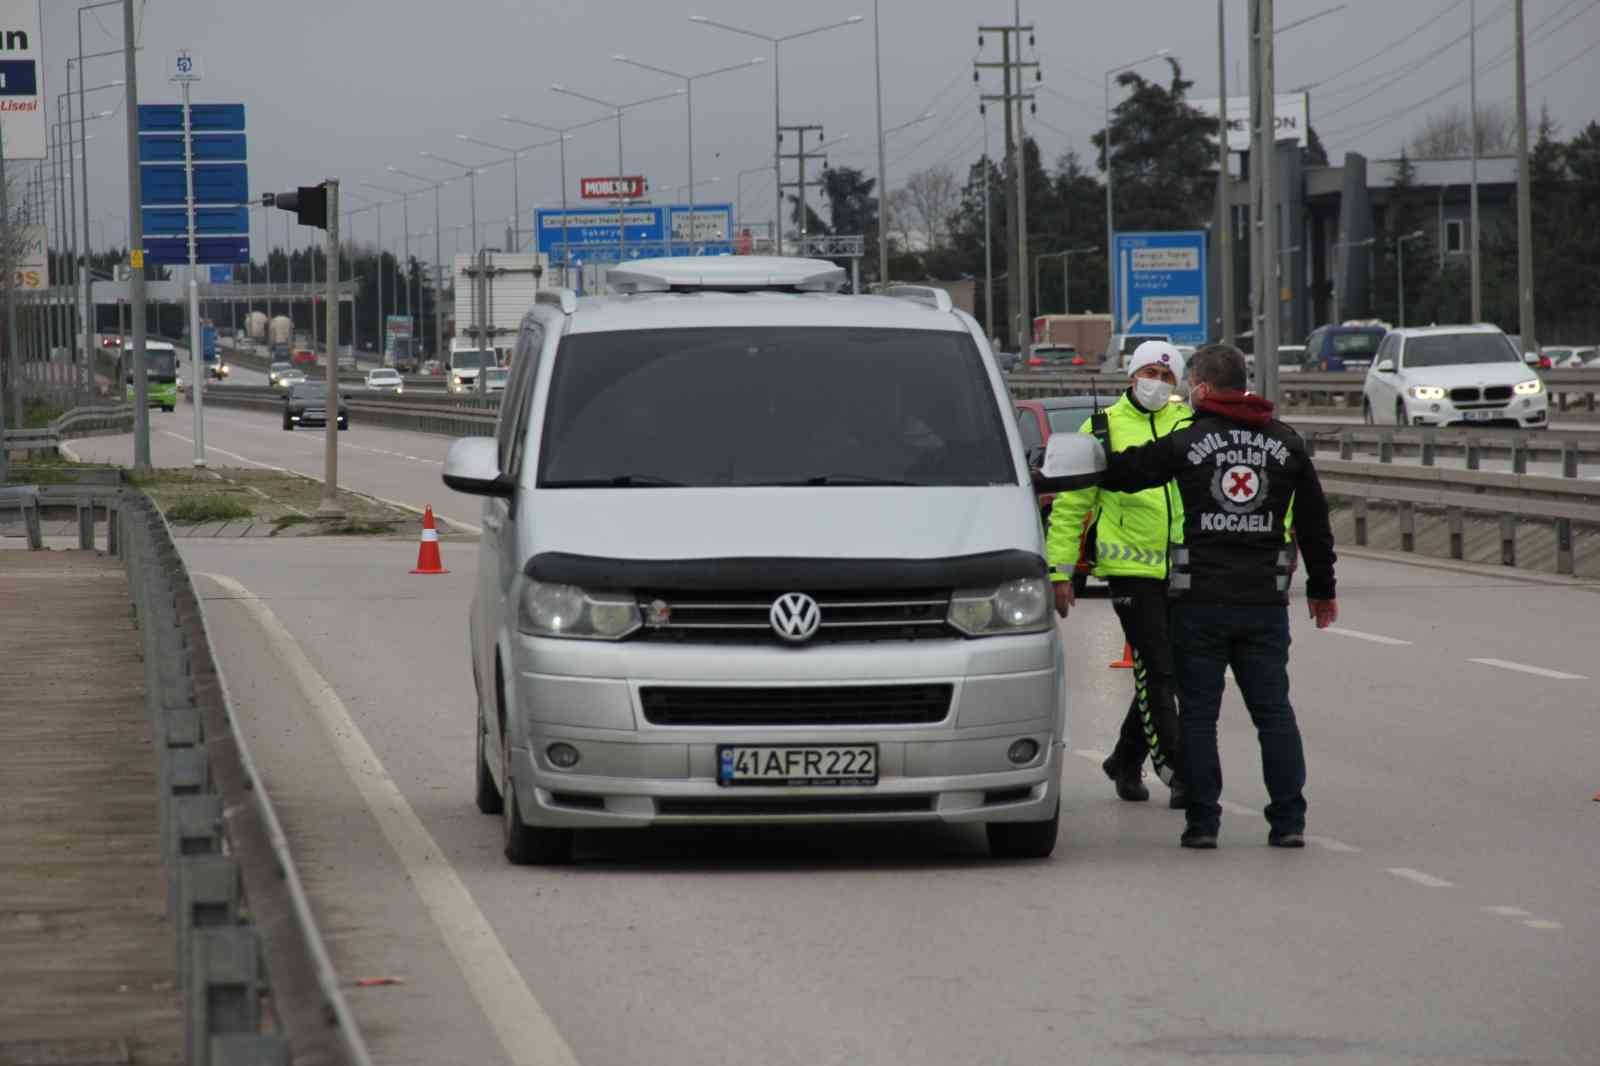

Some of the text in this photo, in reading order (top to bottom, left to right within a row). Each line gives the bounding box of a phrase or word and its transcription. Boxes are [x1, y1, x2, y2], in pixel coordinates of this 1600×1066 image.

[1, 100, 38, 111] Lisesi
[1187, 429, 1291, 466] SİVİL TRAFİK
[1216, 447, 1267, 467] POLİSİ
[1200, 511, 1273, 532] KOCAELİ
